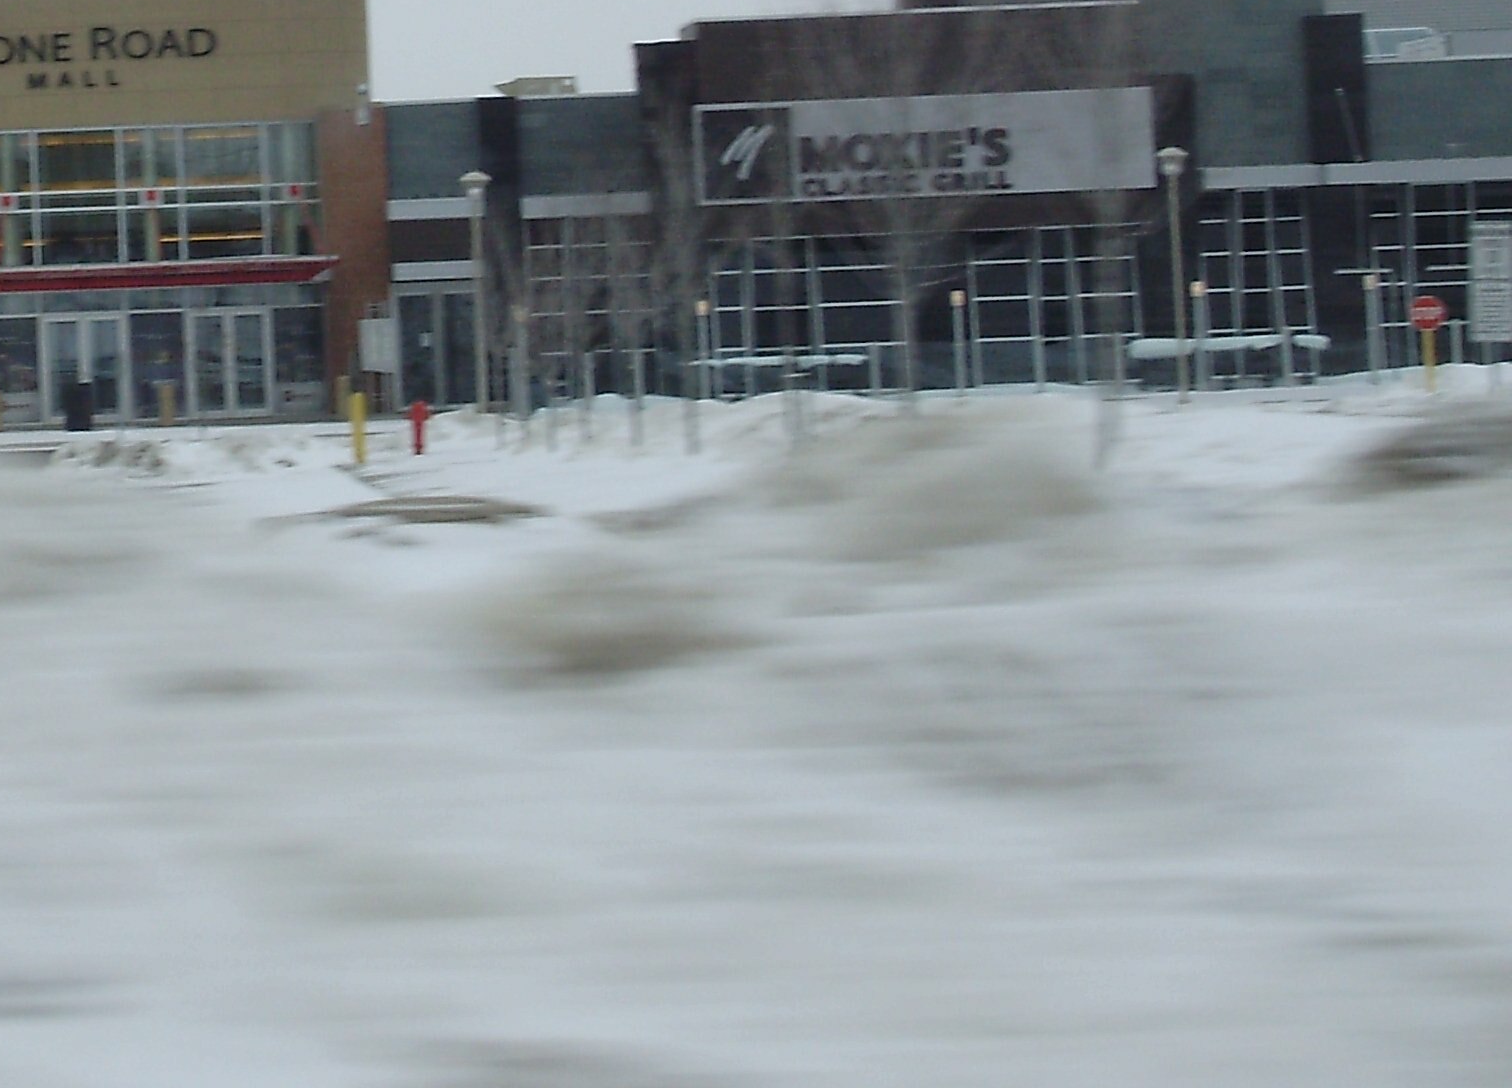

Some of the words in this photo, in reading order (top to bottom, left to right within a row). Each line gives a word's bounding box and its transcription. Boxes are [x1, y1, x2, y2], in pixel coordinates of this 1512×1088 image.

[91, 27, 218, 60] ROAD
[27, 69, 120, 89] MALL
[798, 126, 1014, 174] MOXIE'S
